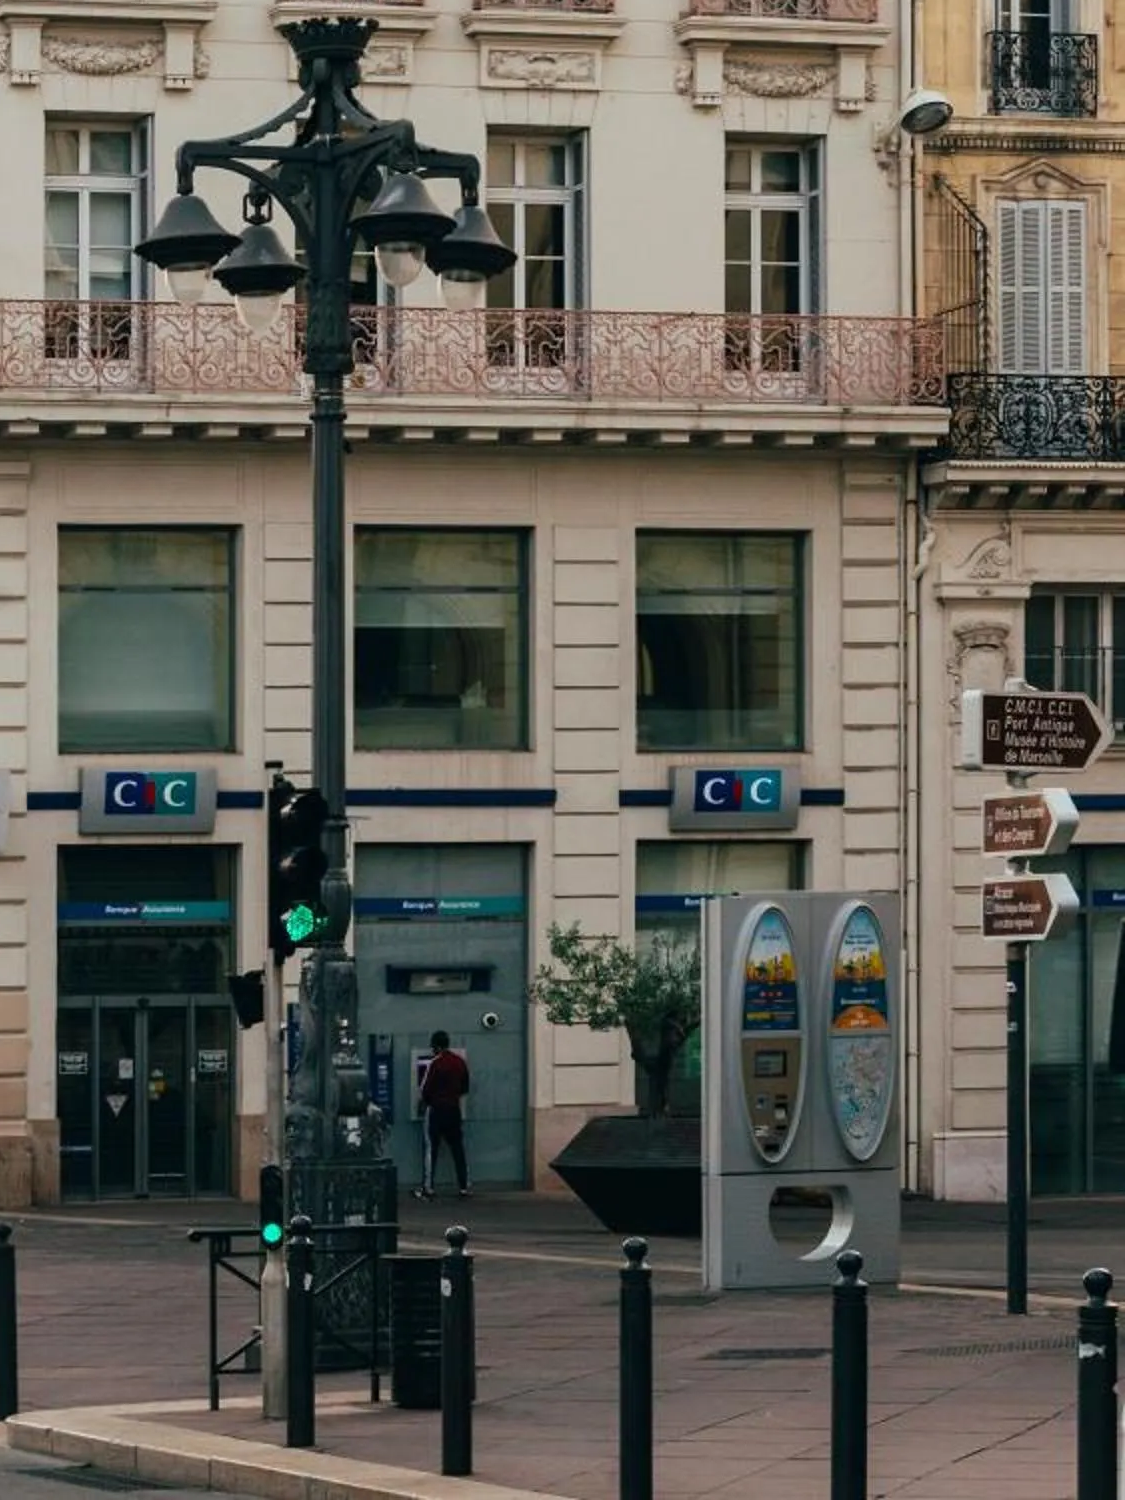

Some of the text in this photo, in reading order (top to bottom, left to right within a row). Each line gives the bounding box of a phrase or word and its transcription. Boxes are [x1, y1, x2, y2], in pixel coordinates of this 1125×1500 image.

[1004, 715, 1076, 736] Port Antique
[1004, 731, 1087, 750] Musée d'Histoire
[1004, 748, 1064, 765] de Marseille
[112, 779, 188, 808] CIC
[702, 777, 773, 805] CIC
